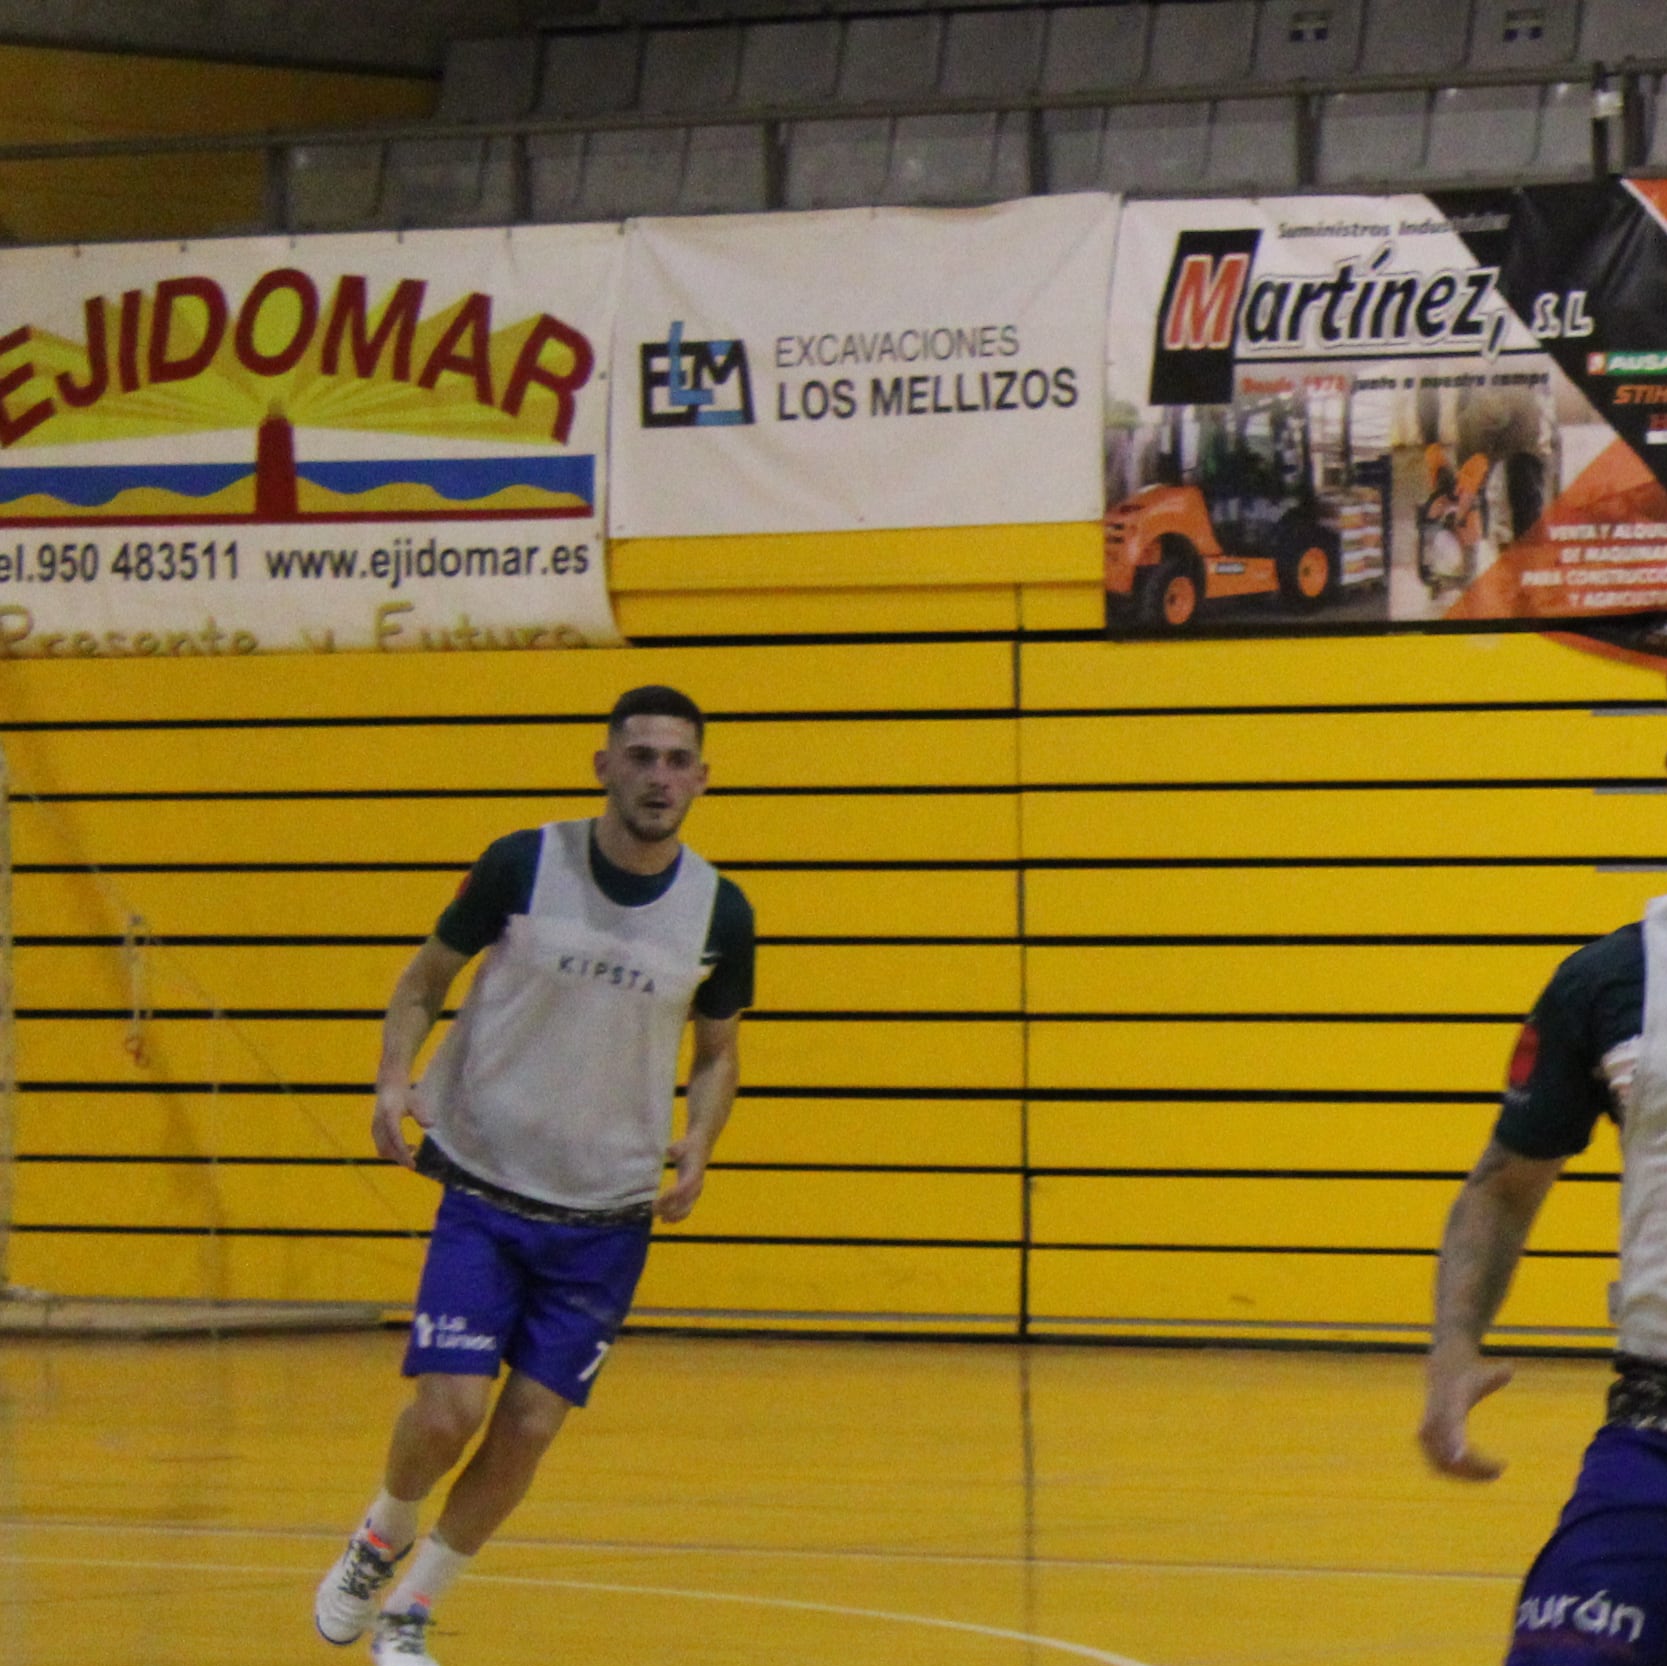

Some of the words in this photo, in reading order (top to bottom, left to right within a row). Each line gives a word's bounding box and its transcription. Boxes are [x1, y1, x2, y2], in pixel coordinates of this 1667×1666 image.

[0, 268, 595, 448] EJIDOMAR
[776, 325, 1020, 368] EXCAVACIONES
[778, 380, 856, 421] LOS
[870, 367, 1079, 416] MELLIZOS
[0, 543, 99, 583] el.950
[111, 541, 239, 580] 483511
[265, 537, 590, 588] www.ejidomar.es
[558, 956, 655, 993] KIPSTA
